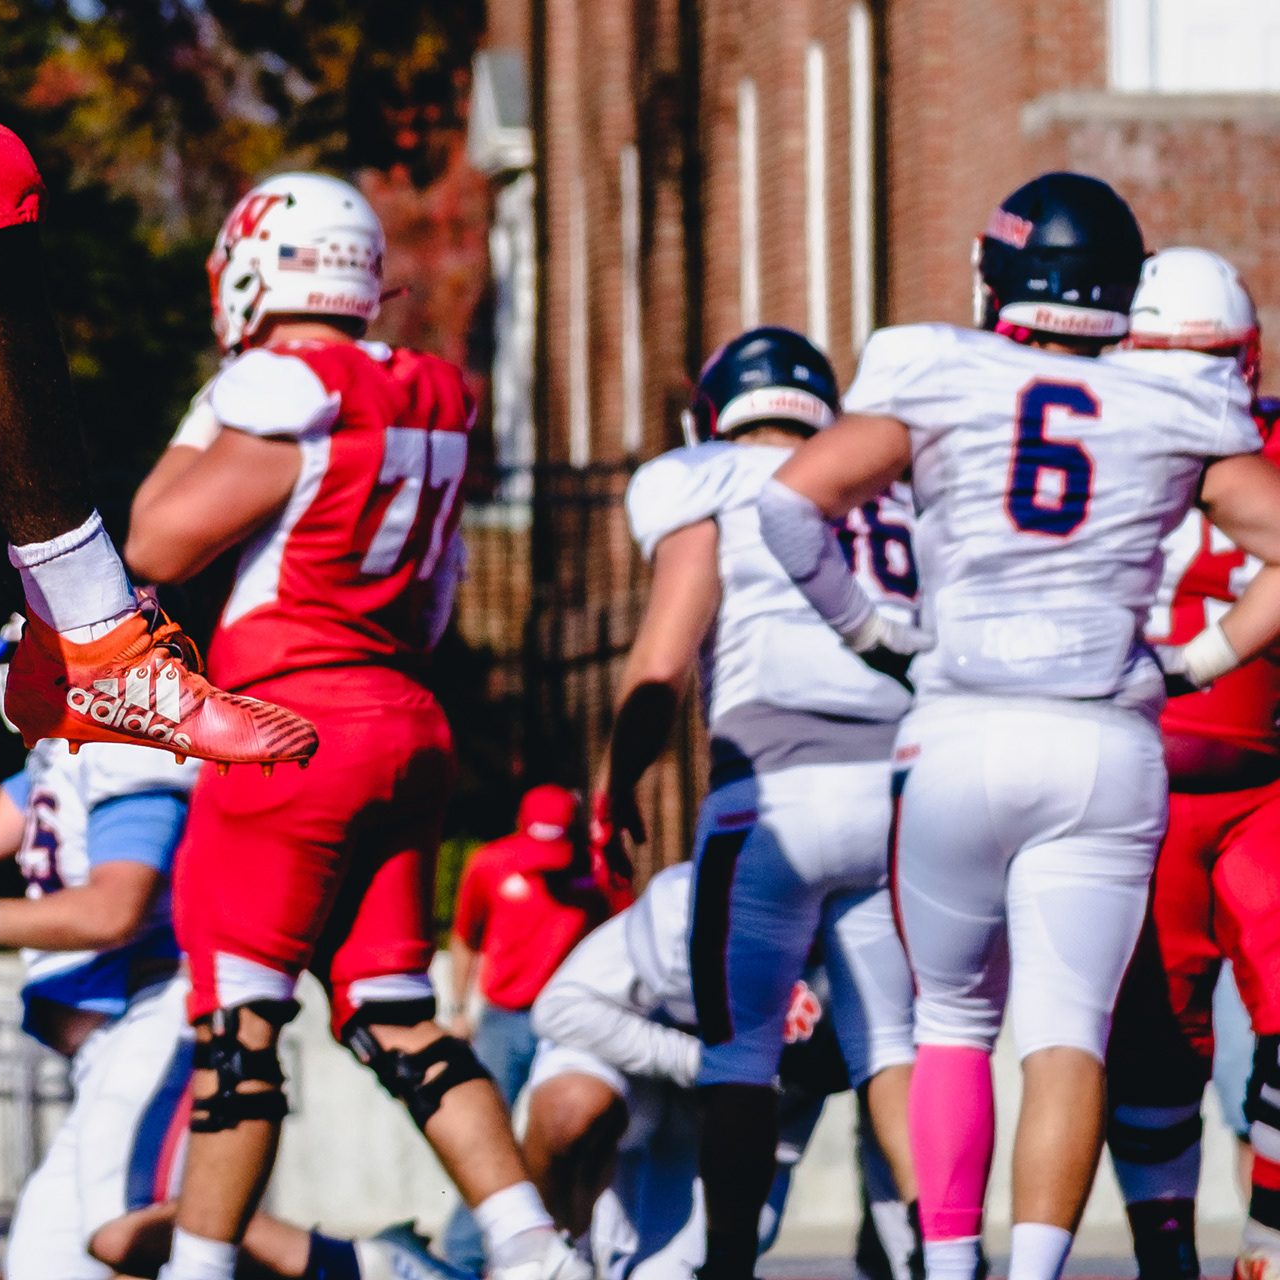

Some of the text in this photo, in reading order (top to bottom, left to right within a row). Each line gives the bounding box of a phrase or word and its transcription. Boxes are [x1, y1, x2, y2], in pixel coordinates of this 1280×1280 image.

[1034, 308, 1116, 332] Riddell
[360, 427, 468, 580] 77
[1004, 376, 1101, 540] 6
[67, 687, 192, 751] adidas
